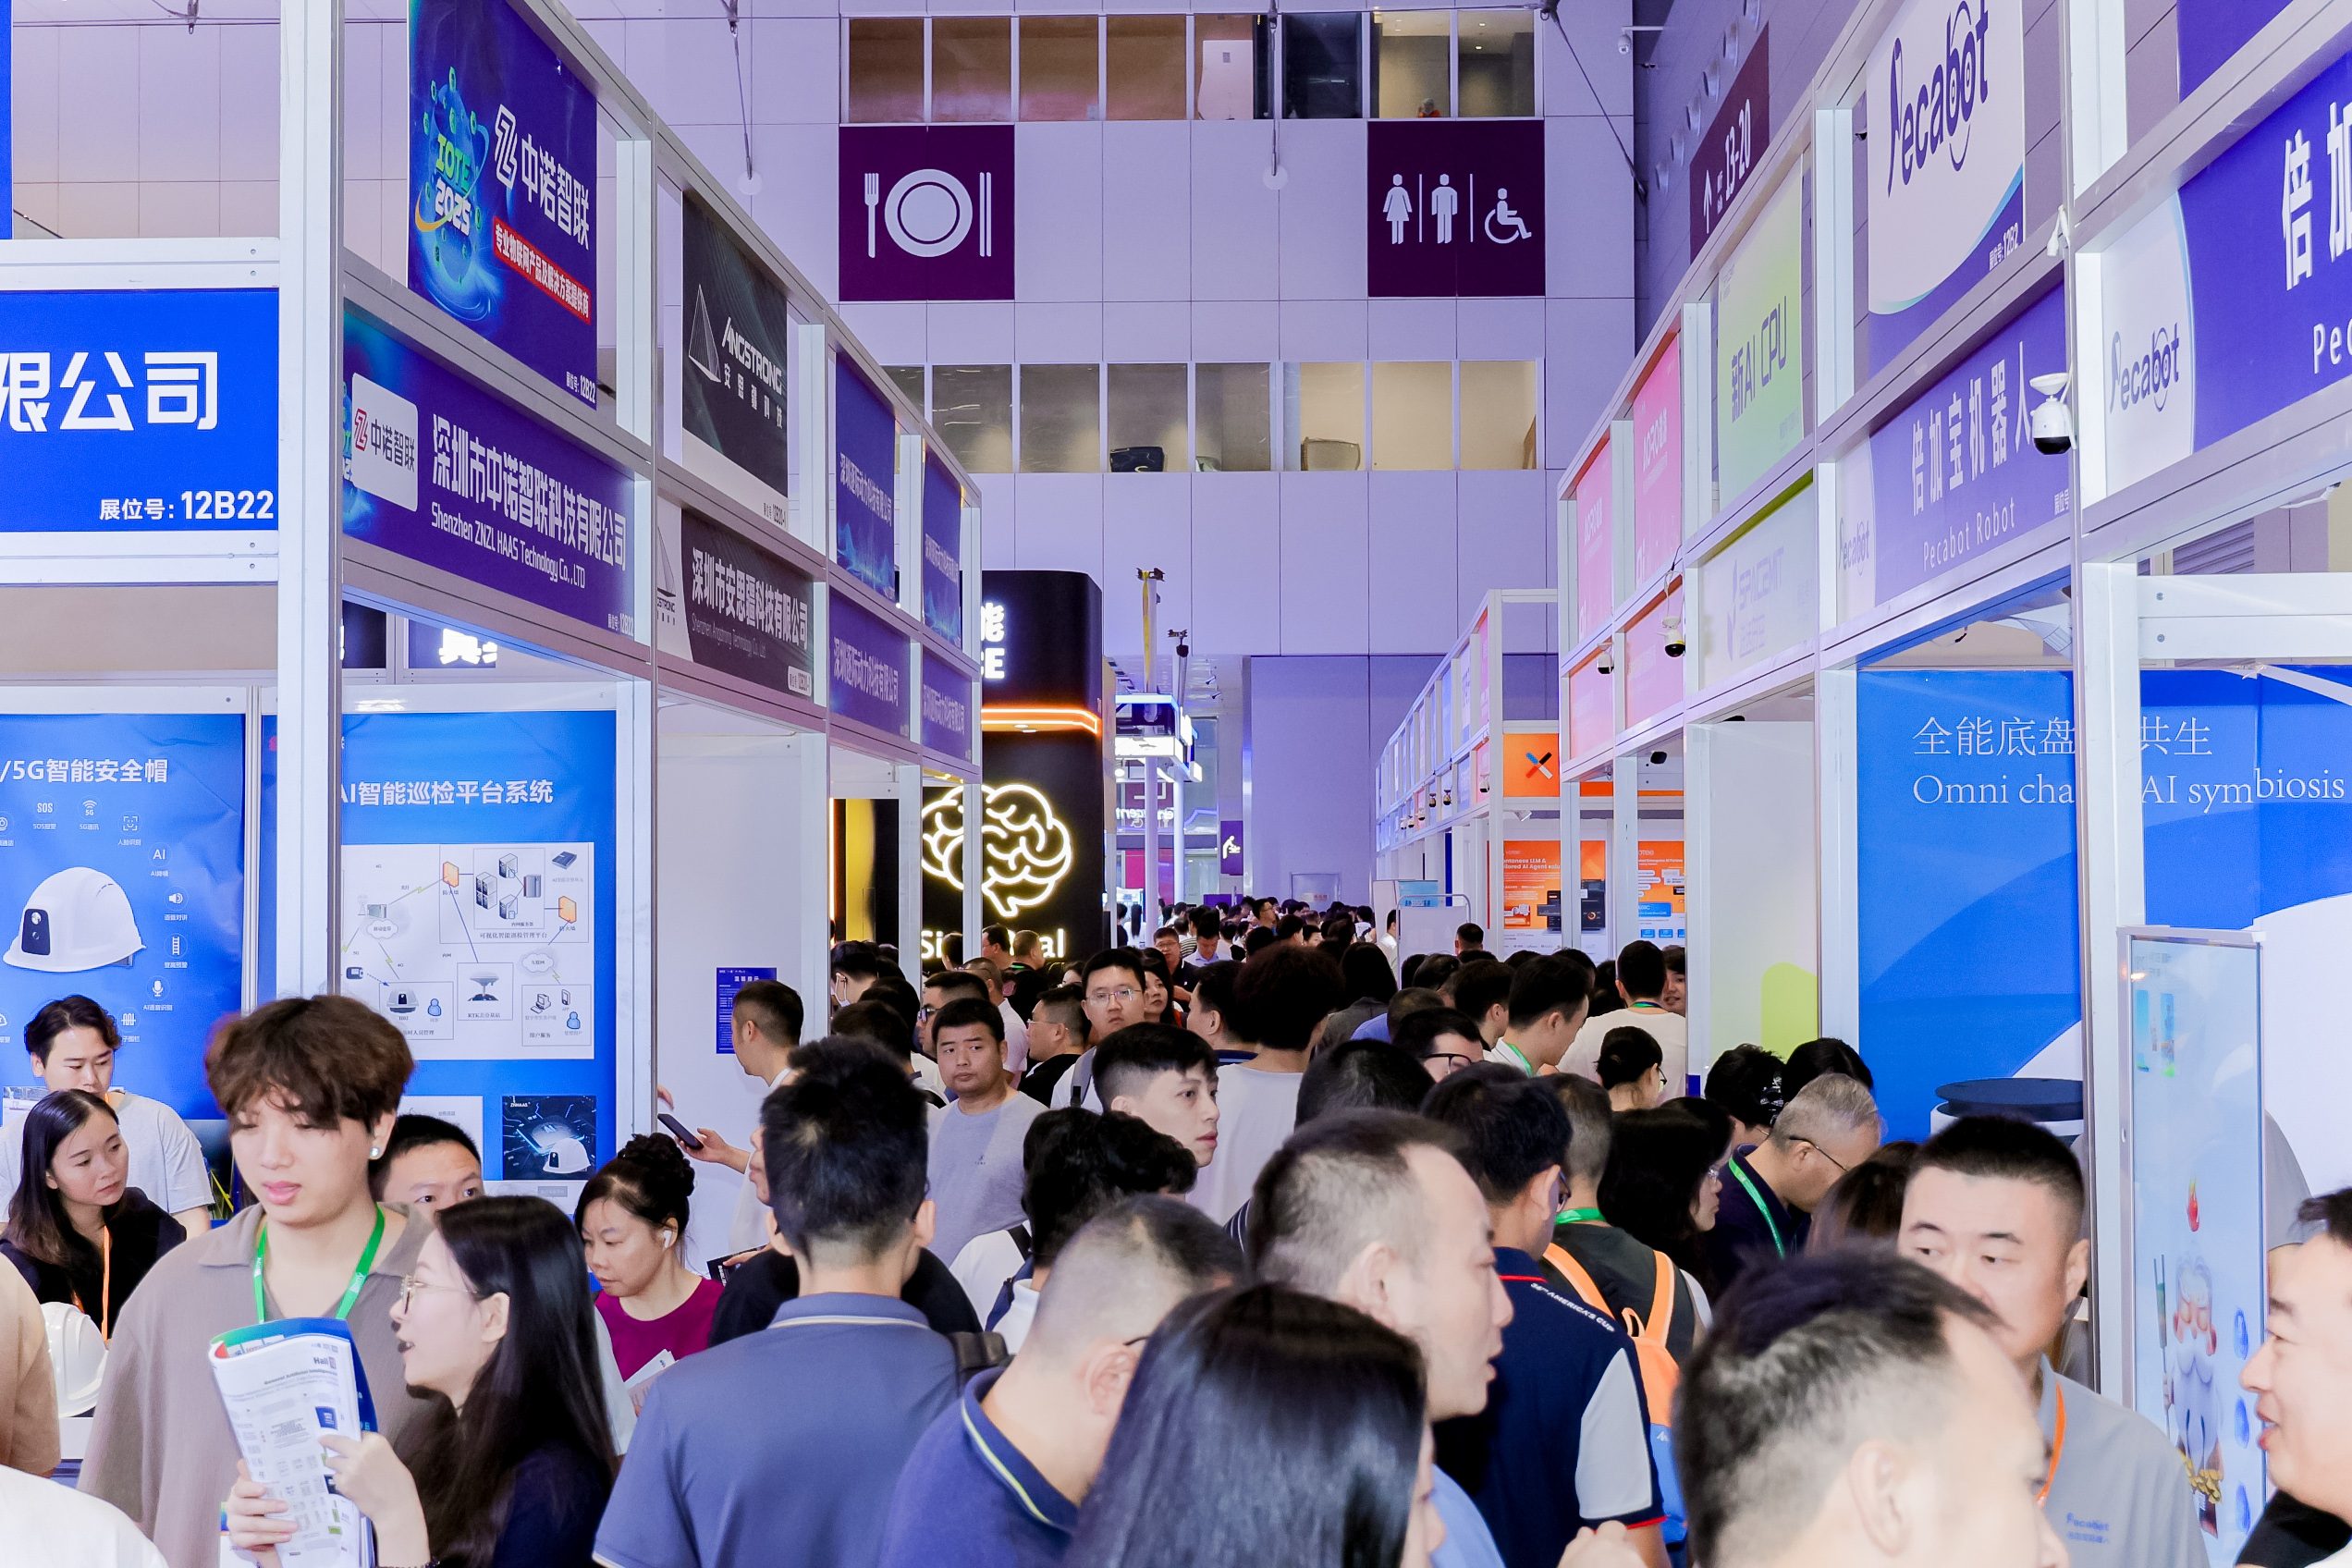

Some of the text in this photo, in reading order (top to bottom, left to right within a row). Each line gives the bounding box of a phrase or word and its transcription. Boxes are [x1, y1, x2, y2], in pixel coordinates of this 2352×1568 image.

[436, 134, 472, 193] IOTE
[1725, 98, 1751, 201] 13-20
[435, 177, 471, 237] 2025
[521, 133, 589, 250] 中诺智联
[722, 316, 782, 395] ANGSTRONG
[580, 375, 596, 404] 12B22
[371, 419, 415, 472] 中诺智联
[1912, 342, 2031, 517] 倍加宝机器人
[180, 490, 274, 520] 12B22
[432, 413, 627, 571] 深圳市中诺智联科技有限公司
[431, 501, 472, 543] Shenzhen
[474, 521, 496, 552] ZNZL
[497, 530, 519, 561] HAAS
[520, 540, 558, 583] Technology
[1924, 496, 2015, 572] Pecabot Robot
[1913, 717, 2213, 755] 全能底盘 共生
[37, 802, 54, 814] SOS
[1913, 774, 2008, 804] Omni
[2141, 775, 2178, 804] AI
[2188, 767, 2345, 814] symbiosis
[153, 849, 166, 861] AI
[1596, 1317, 1615, 1332] CUP
